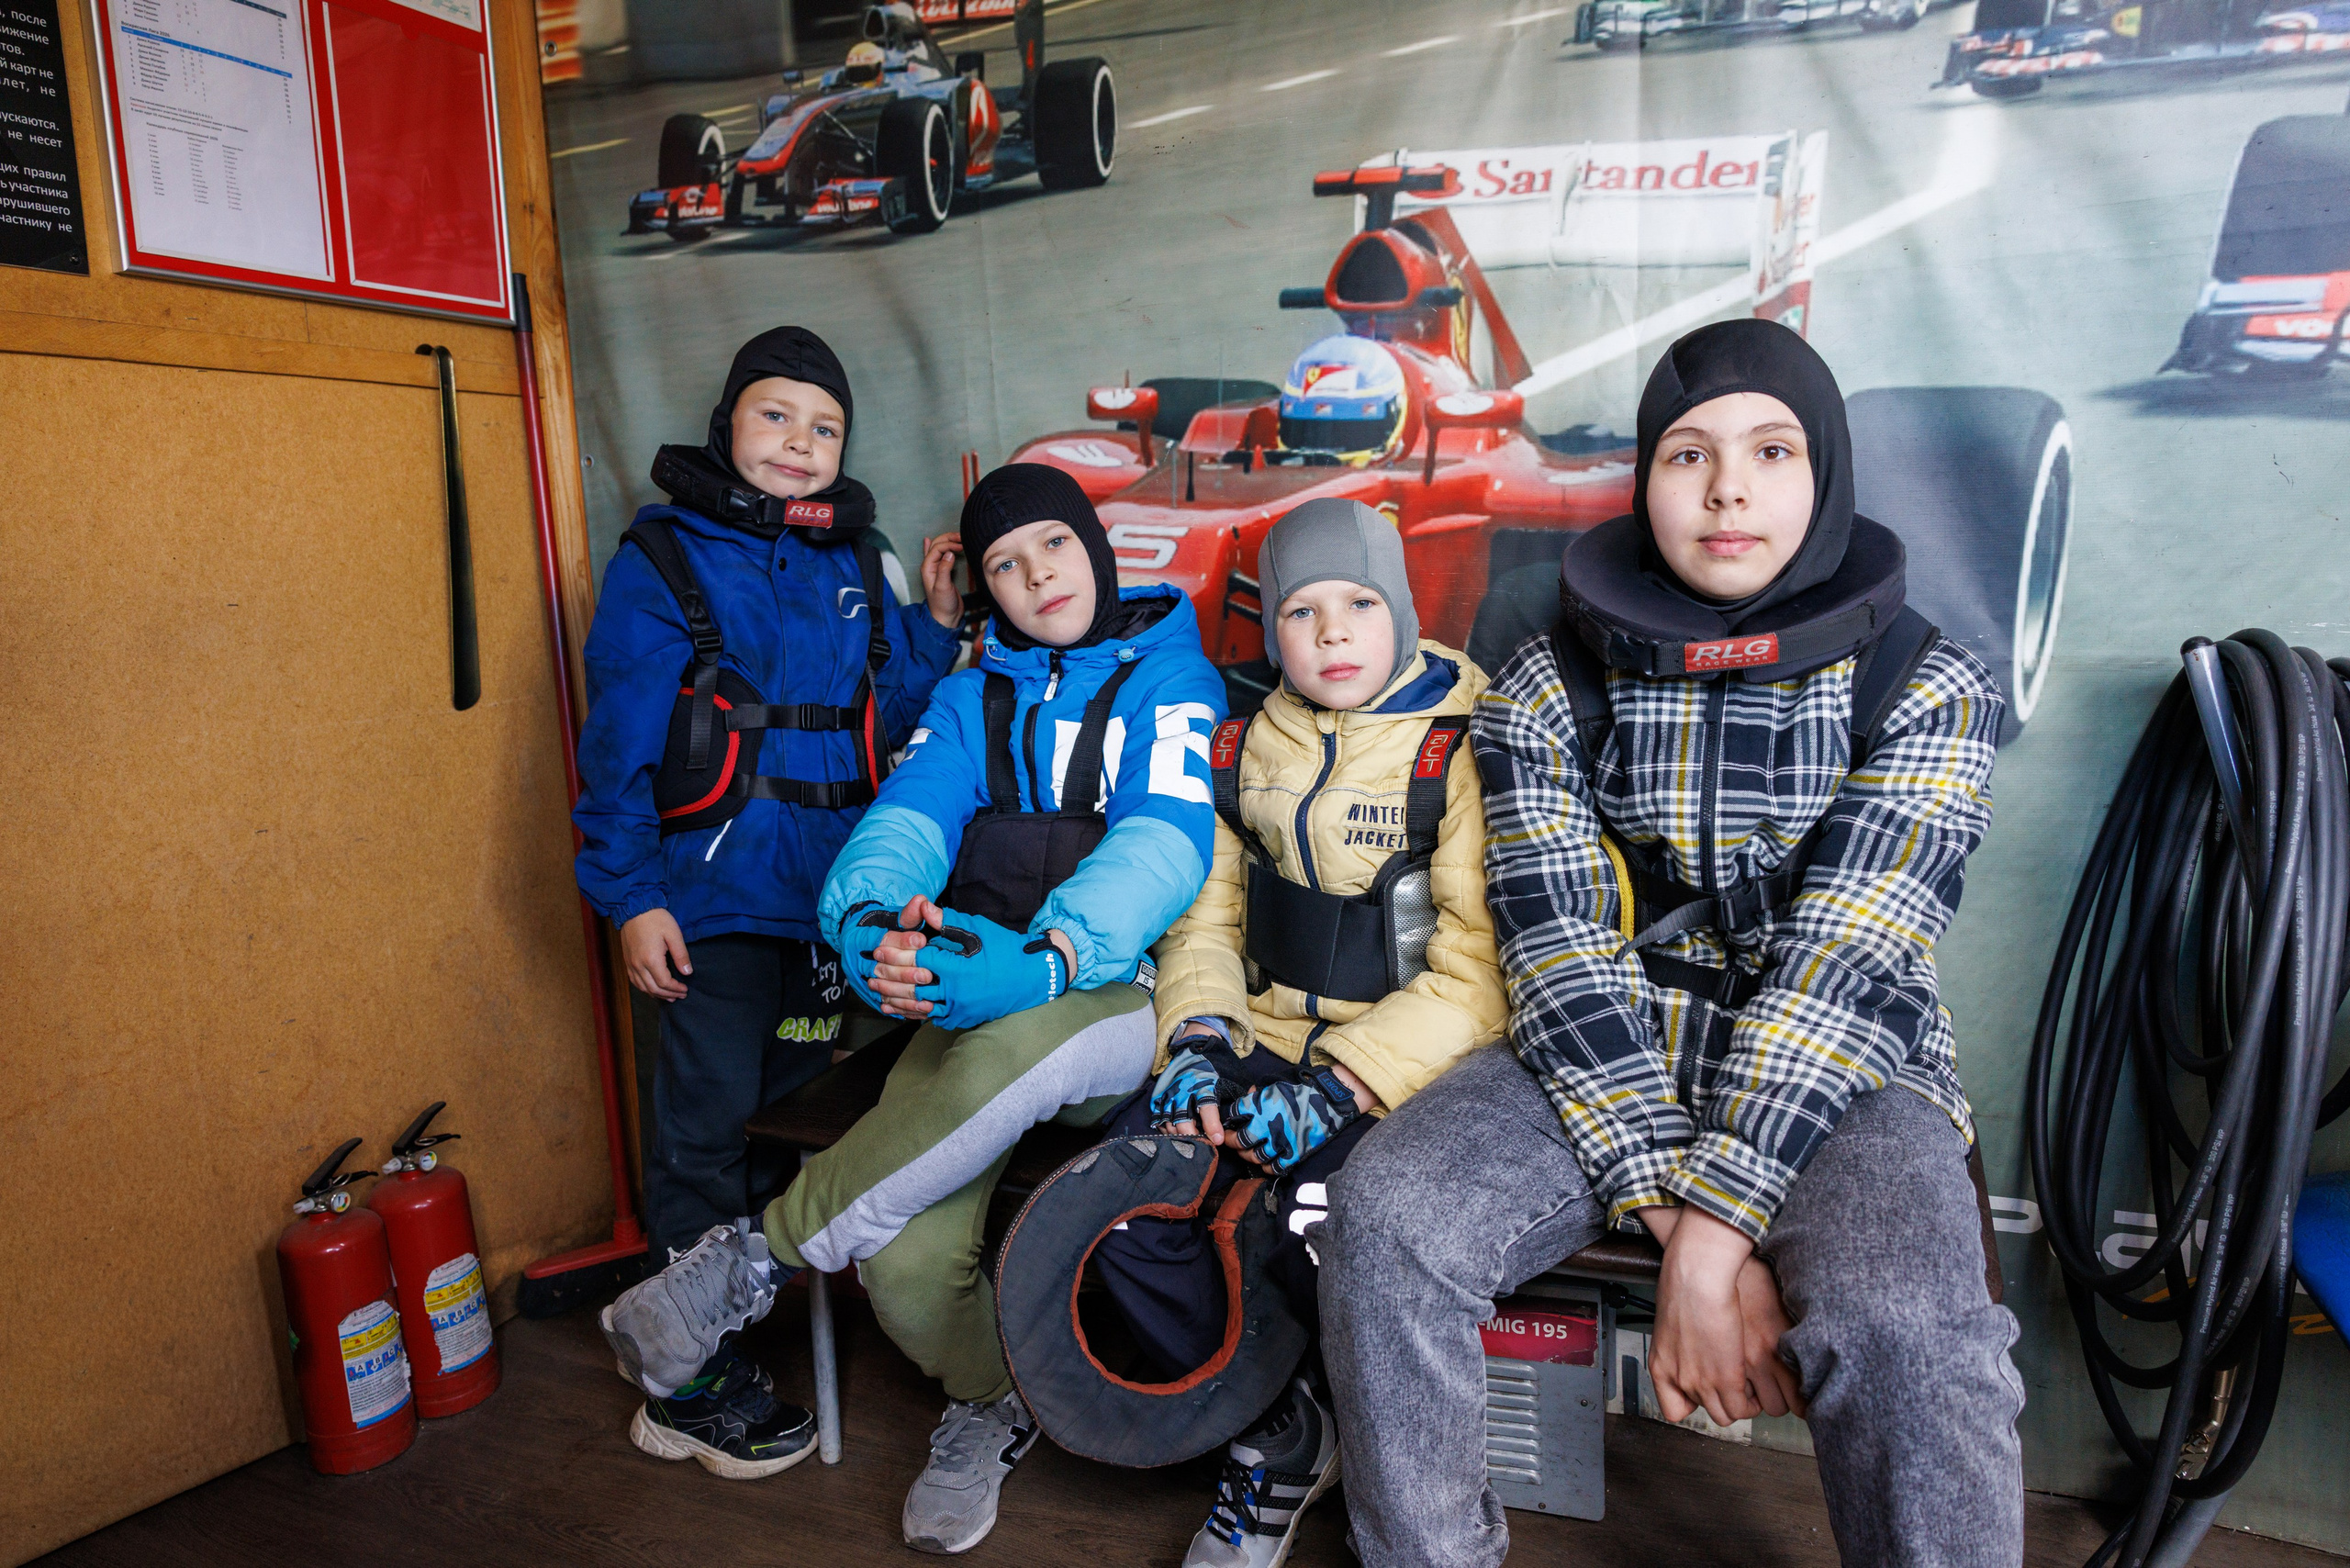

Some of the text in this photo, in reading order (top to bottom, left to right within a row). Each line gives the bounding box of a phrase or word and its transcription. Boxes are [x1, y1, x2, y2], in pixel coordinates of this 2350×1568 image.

[11, 10, 47, 28] после
[10, 62, 37, 75] карт
[39, 69, 54, 80] не
[40, 85, 56, 96] не
[7, 129, 62, 148] не несет
[23, 167, 66, 182] правил
[8, 181, 68, 199] участника
[58, 223, 73, 233] не
[789, 505, 830, 517] RLG
[1108, 523, 1192, 569] 5
[1693, 639, 1771, 661] RLG
[2297, 733, 2305, 743] WP
[2297, 743, 2305, 753] PSI
[2297, 755, 2305, 766] 300
[2269, 790, 2276, 801] WP
[2269, 802, 2277, 814] PSI
[2294, 795, 2303, 812] Hose
[1344, 830, 1406, 849] JACKET
[2289, 822, 2300, 844] Hybrid
[2295, 887, 2304, 898] PSI
[2295, 899, 2303, 912] 300
[2294, 973, 2304, 995] Hybrid
[2293, 995, 2302, 1025] Premium
[1322, 1077, 1346, 1098] SPORT
[2215, 1128, 2226, 1140] WP
[2211, 1138, 2222, 1151] PSI
[2206, 1149, 2218, 1162] 300
[2203, 1164, 2212, 1173] ID
[2191, 1185, 2203, 1201] Hose
[2226, 1193, 2235, 1205] WP
[2188, 1199, 2197, 1209] Air
[2223, 1205, 2233, 1217] PSI
[2221, 1217, 2230, 1230] 300
[2280, 1219, 2289, 1233] 3/8"
[2218, 1233, 2227, 1241] ID
[2215, 1242, 2226, 1255] 3/8"
[2279, 1237, 2288, 1255] Hose
[2211, 1259, 2222, 1276] Hose
[2278, 1256, 2287, 1266] Air
[2209, 1276, 2218, 1286] Air
[2240, 1276, 2252, 1288] WP
[2204, 1285, 2217, 1306] Hybrid
[2236, 1285, 2248, 1298] PSI
[2232, 1296, 2243, 1308] 300
[2200, 1306, 2212, 1333] Premium
[1532, 1322, 1567, 1339] 195
